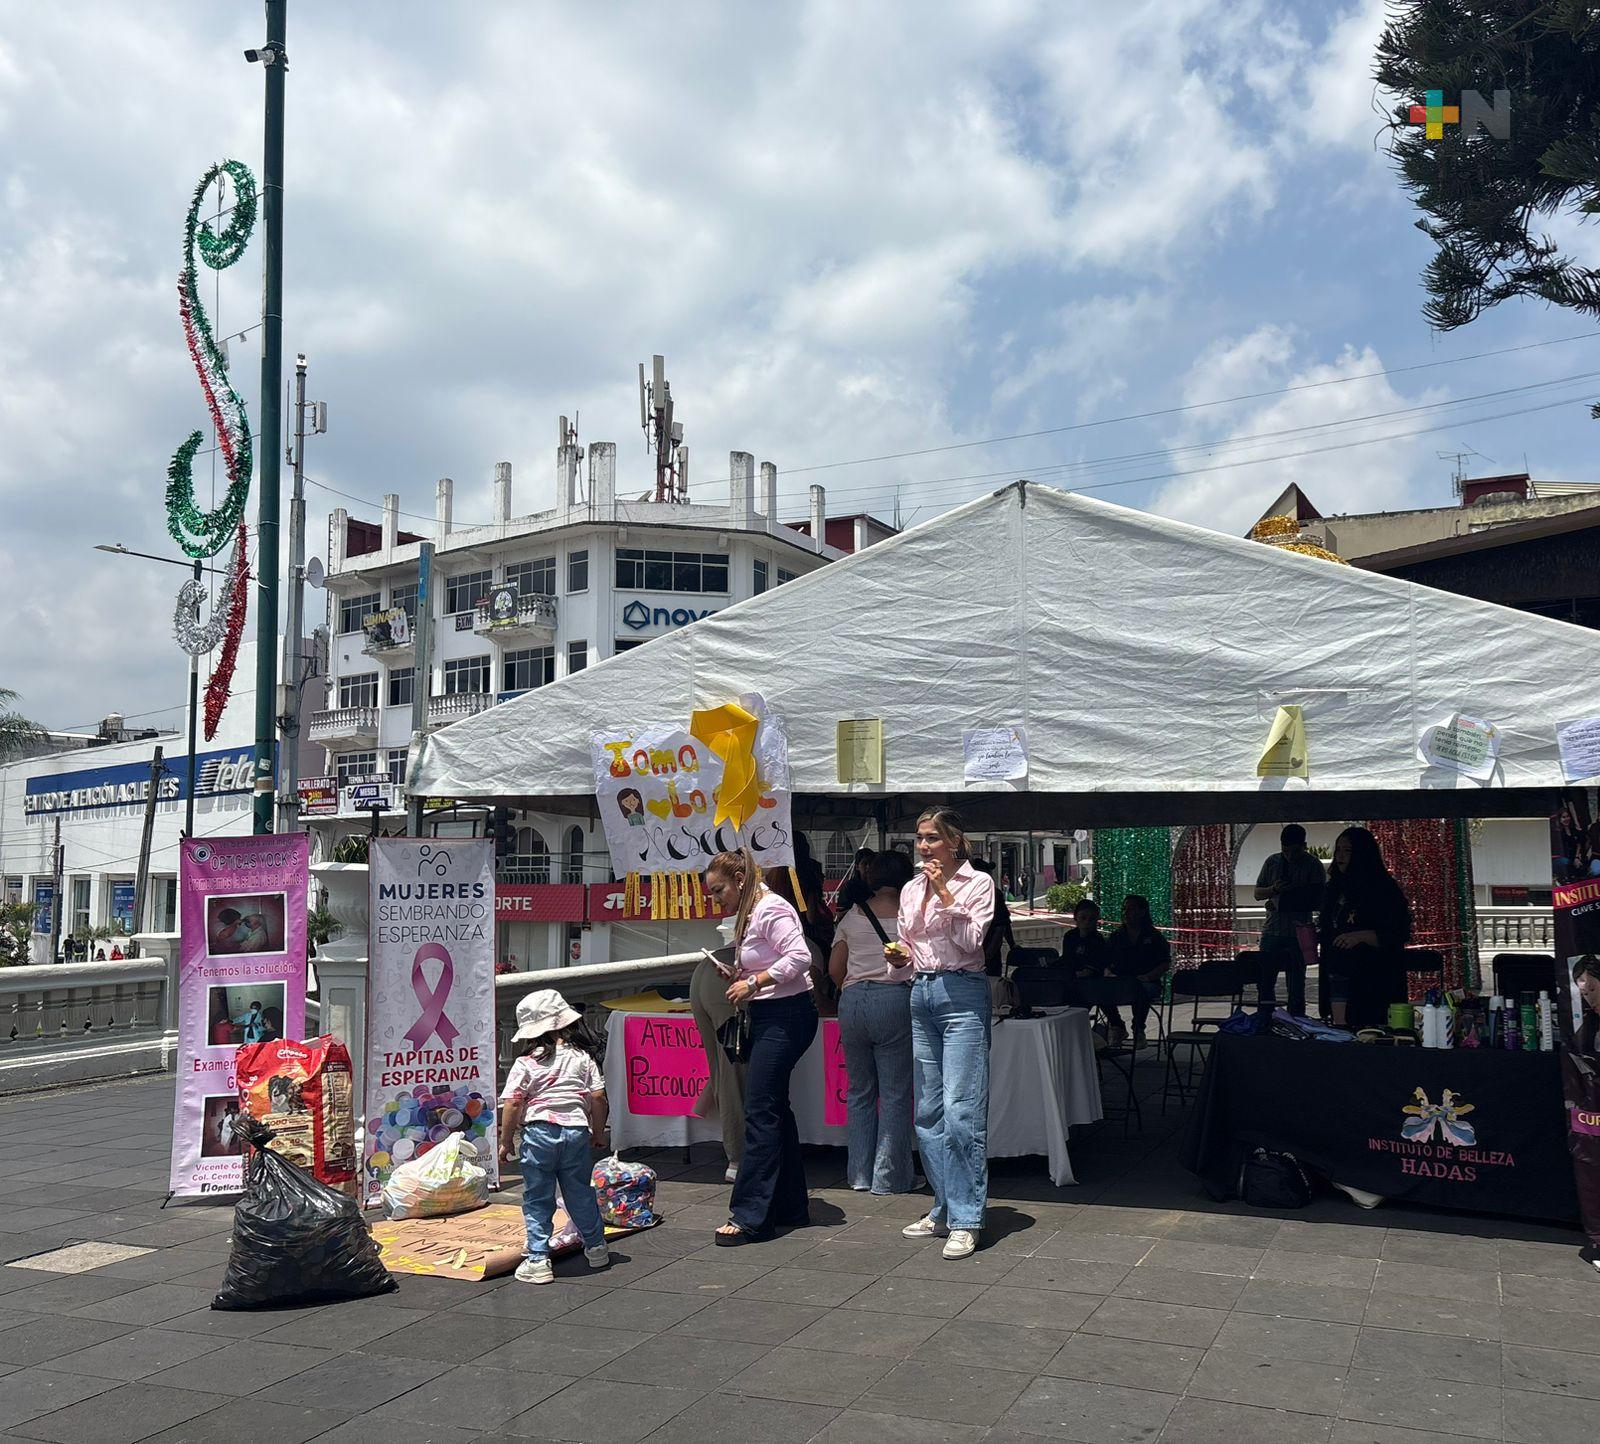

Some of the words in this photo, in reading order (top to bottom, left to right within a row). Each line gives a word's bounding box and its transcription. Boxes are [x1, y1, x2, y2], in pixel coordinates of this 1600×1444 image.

[456, 615, 472, 629] GYM
[379, 883, 485, 900] MUJERES
[379, 904, 485, 921] SEMBRANDO
[1571, 904, 1594, 916] CLAVE
[379, 924, 485, 943] ESPERANZA
[198, 965, 239, 977] Tenemos
[243, 963, 251, 975] la
[384, 1048, 454, 1067] TAPITAS
[459, 1046, 479, 1061] DE
[382, 1065, 480, 1087] ESPERANZA
[630, 1055, 710, 1097] PSICOLÓG
[1368, 1138, 1432, 1157] INSTITUTO
[1436, 1145, 1453, 1160] DE
[1460, 1149, 1515, 1167] BELLEZA
[195, 1163, 229, 1172] Vicente
[1401, 1157, 1477, 1182] HADAS
